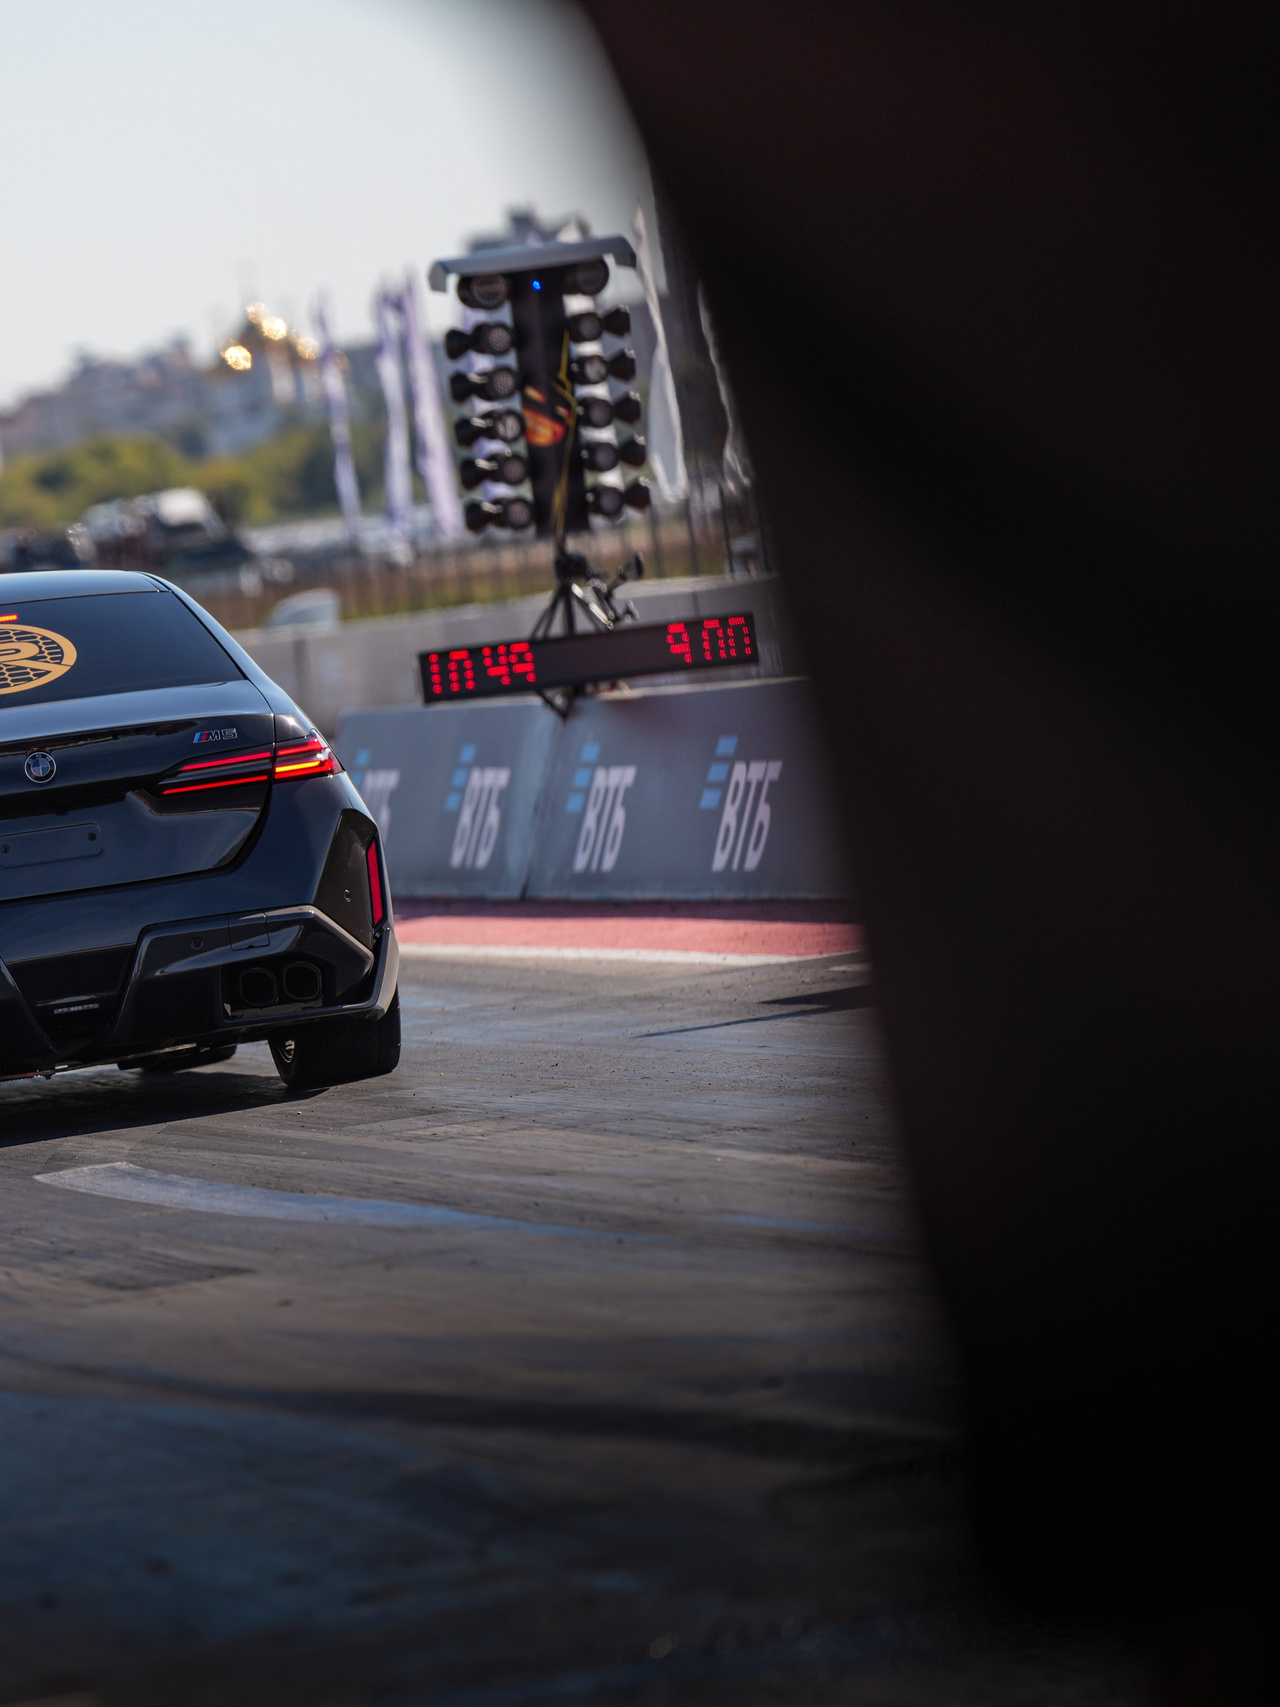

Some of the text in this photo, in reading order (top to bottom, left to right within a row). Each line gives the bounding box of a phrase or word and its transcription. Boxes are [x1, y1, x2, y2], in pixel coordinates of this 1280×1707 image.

[202, 728, 238, 742] M5
[450, 767, 511, 869] ВТБ
[573, 765, 637, 873] ВТБ
[712, 760, 783, 873] ВТБ
